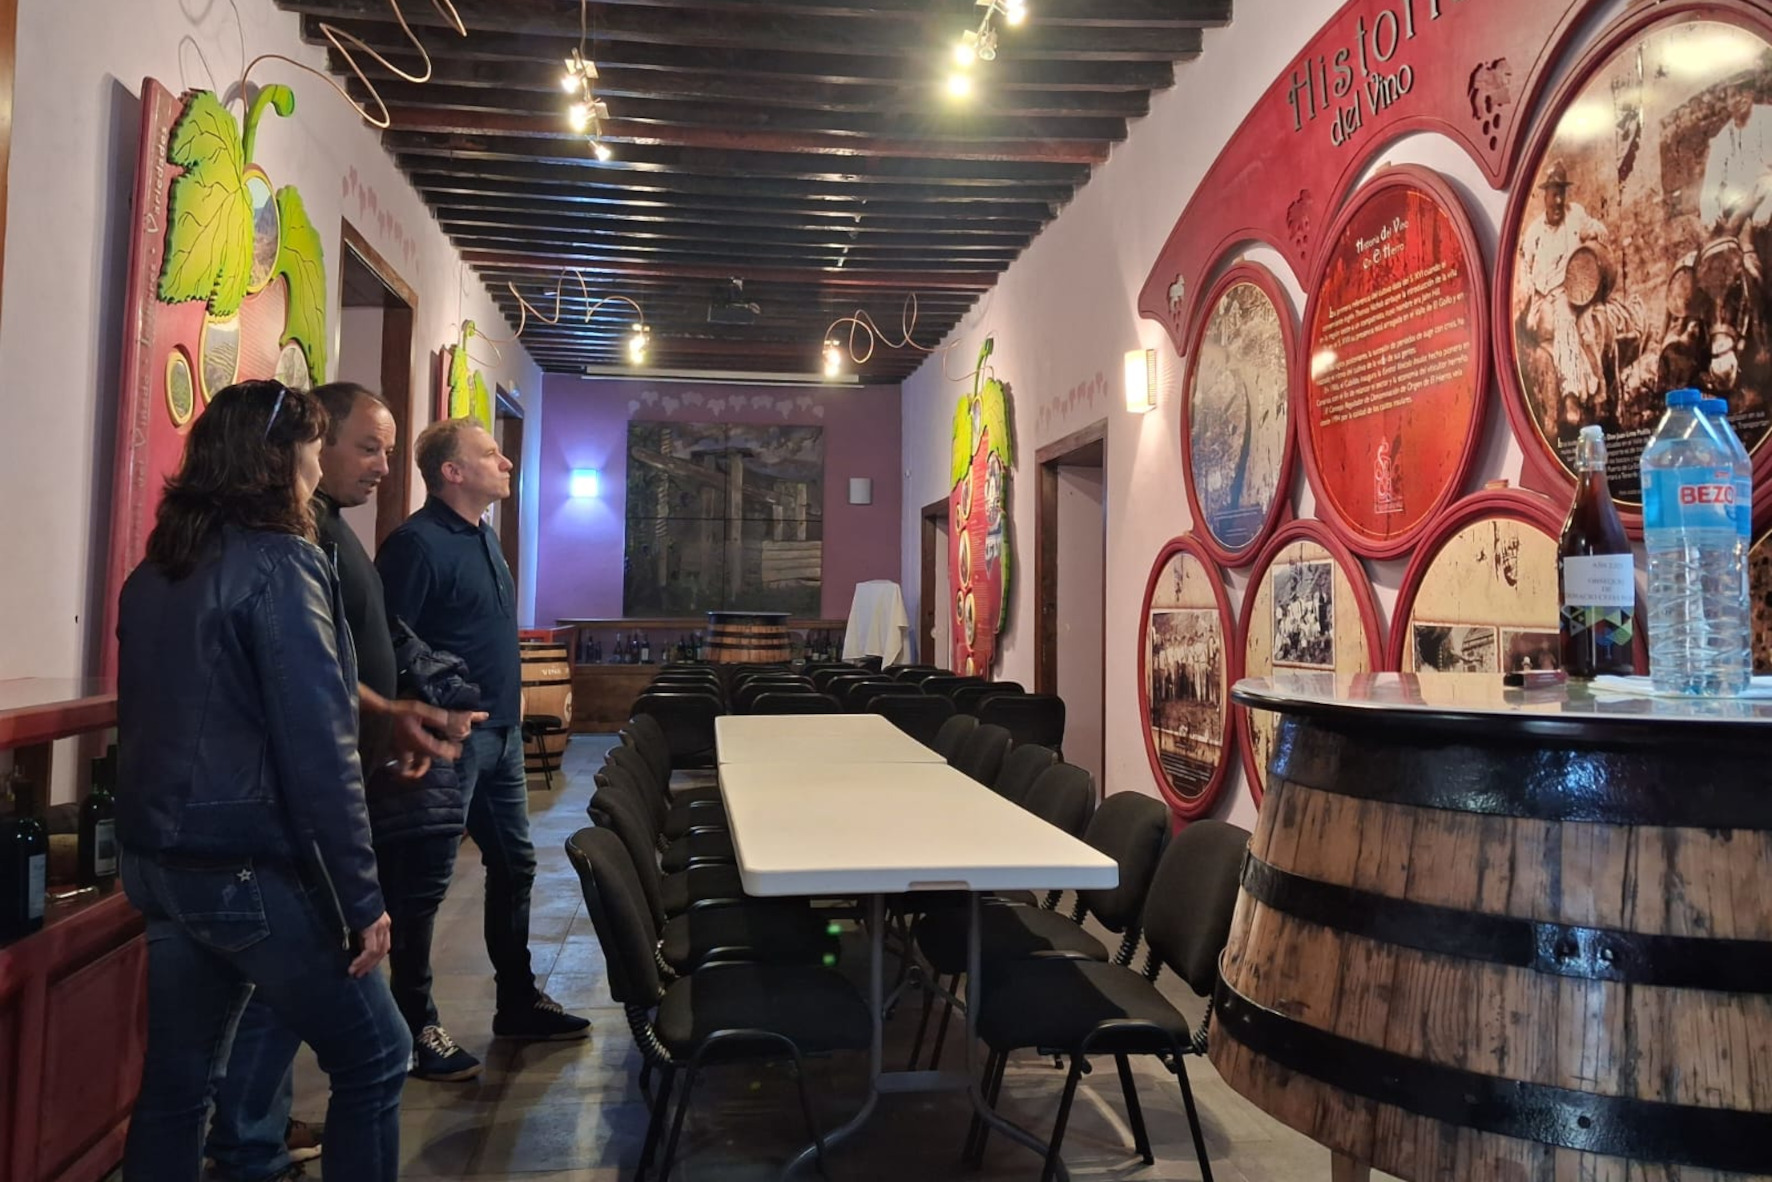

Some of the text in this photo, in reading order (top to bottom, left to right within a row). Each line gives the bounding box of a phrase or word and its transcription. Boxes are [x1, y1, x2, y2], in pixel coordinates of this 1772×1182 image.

[1287, 0, 1442, 131] Histor
[1330, 64, 1414, 147] del Vino
[146, 127, 167, 233] Variedades
